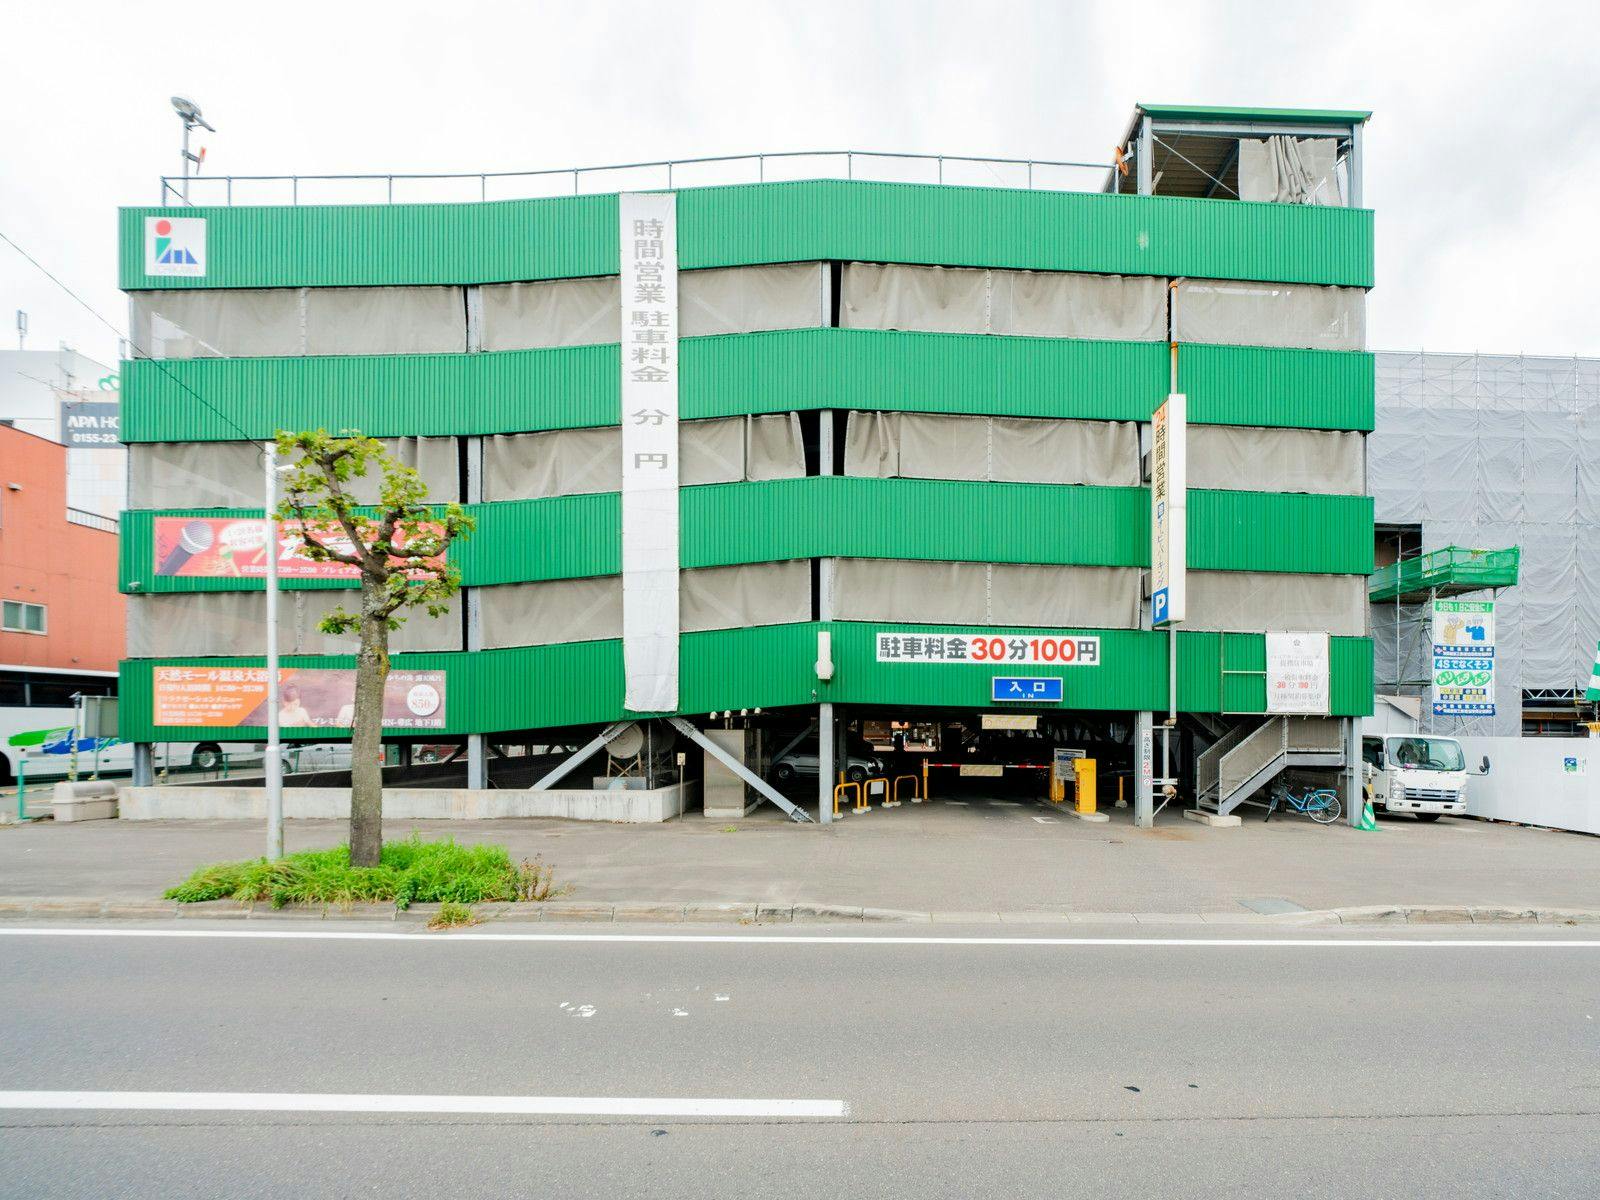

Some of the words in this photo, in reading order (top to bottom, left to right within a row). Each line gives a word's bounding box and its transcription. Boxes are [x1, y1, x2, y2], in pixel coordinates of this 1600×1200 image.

[632, 218, 666, 304] 時間営業
[630, 310, 669, 383] 駐車料金
[67, 415, 98, 428] APA
[631, 408, 669, 426] 分
[634, 453, 668, 469] 円
[1156, 594, 1166, 619] P
[880, 637, 1097, 662] 駐車料金30分100円
[1437, 660, 1490, 669] 4Sでなくそう
[1010, 681, 1046, 693] 入口
